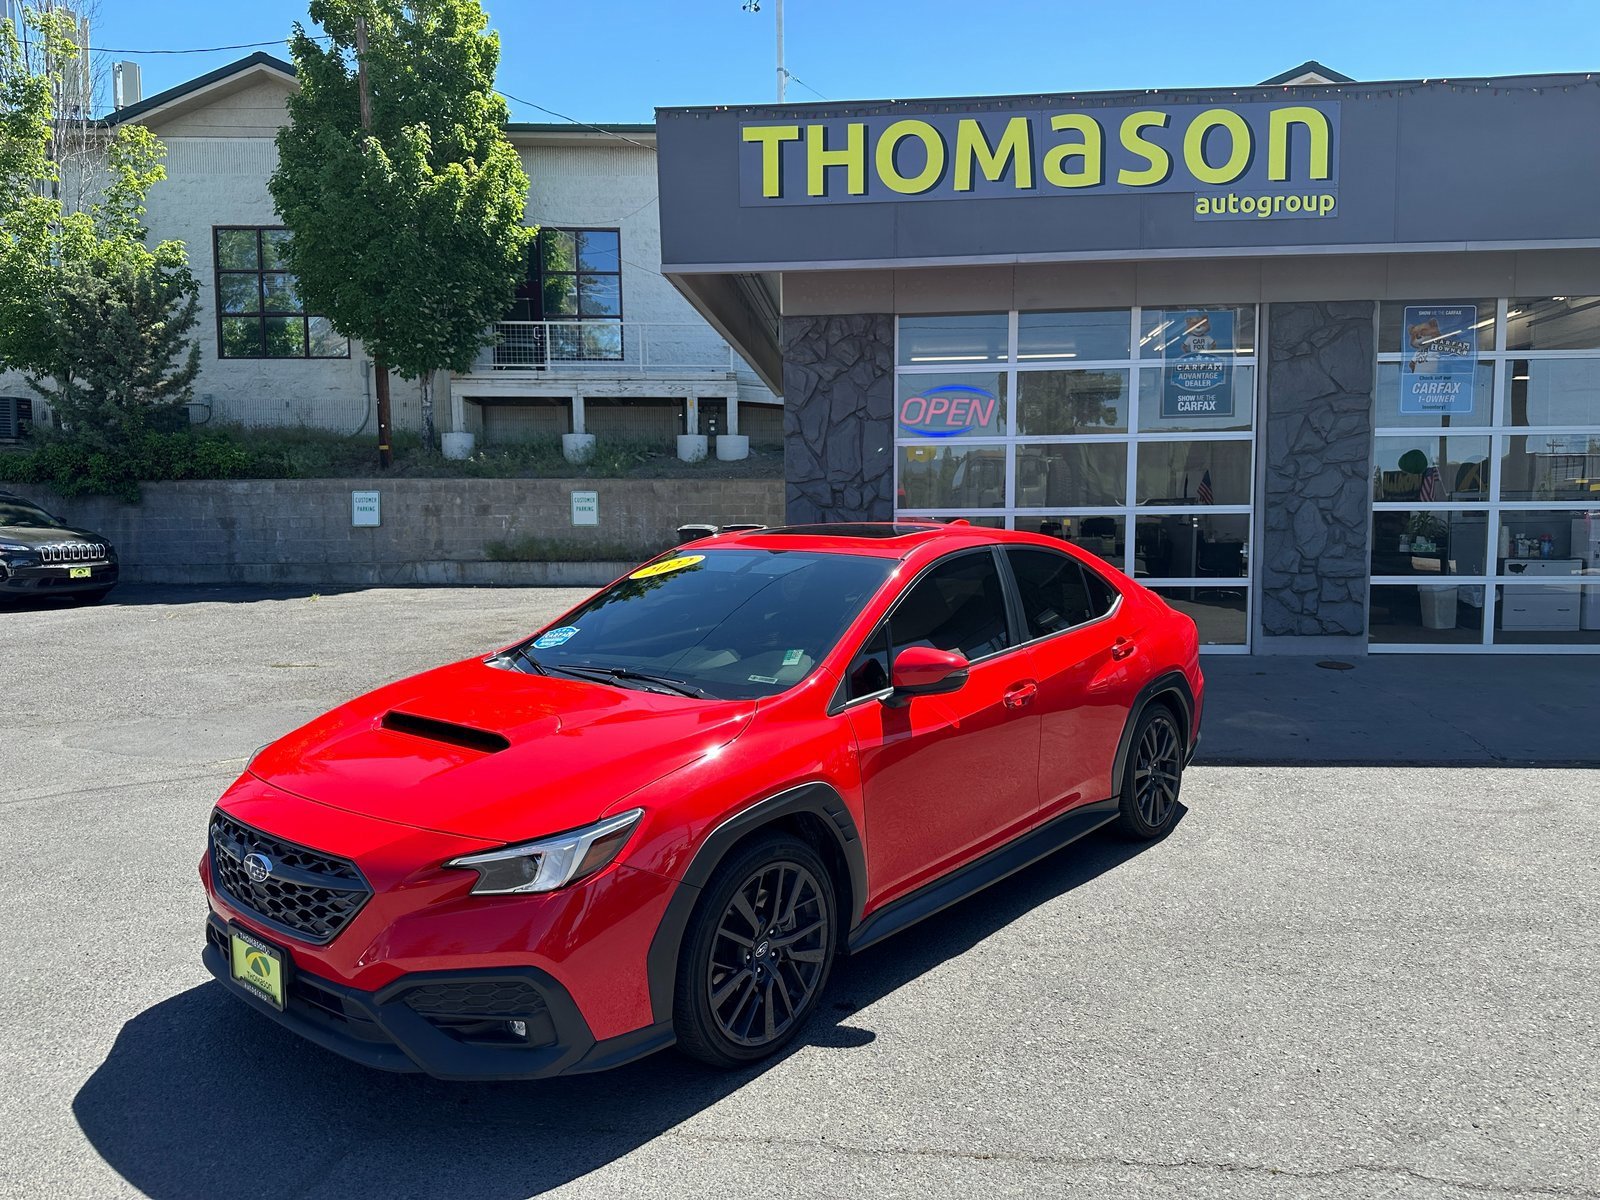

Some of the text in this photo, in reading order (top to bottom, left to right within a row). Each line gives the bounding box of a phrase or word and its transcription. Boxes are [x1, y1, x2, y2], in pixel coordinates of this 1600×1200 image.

[1195, 193, 1336, 218] autogroup
[1176, 362, 1222, 372] CARFAX
[1178, 372, 1218, 380] ADVANTAGE
[1412, 382, 1461, 394] CARFAX
[1418, 394, 1456, 403] 1-OWNER
[1177, 401, 1216, 411] CARFAX
[899, 397, 995, 427] OPEN
